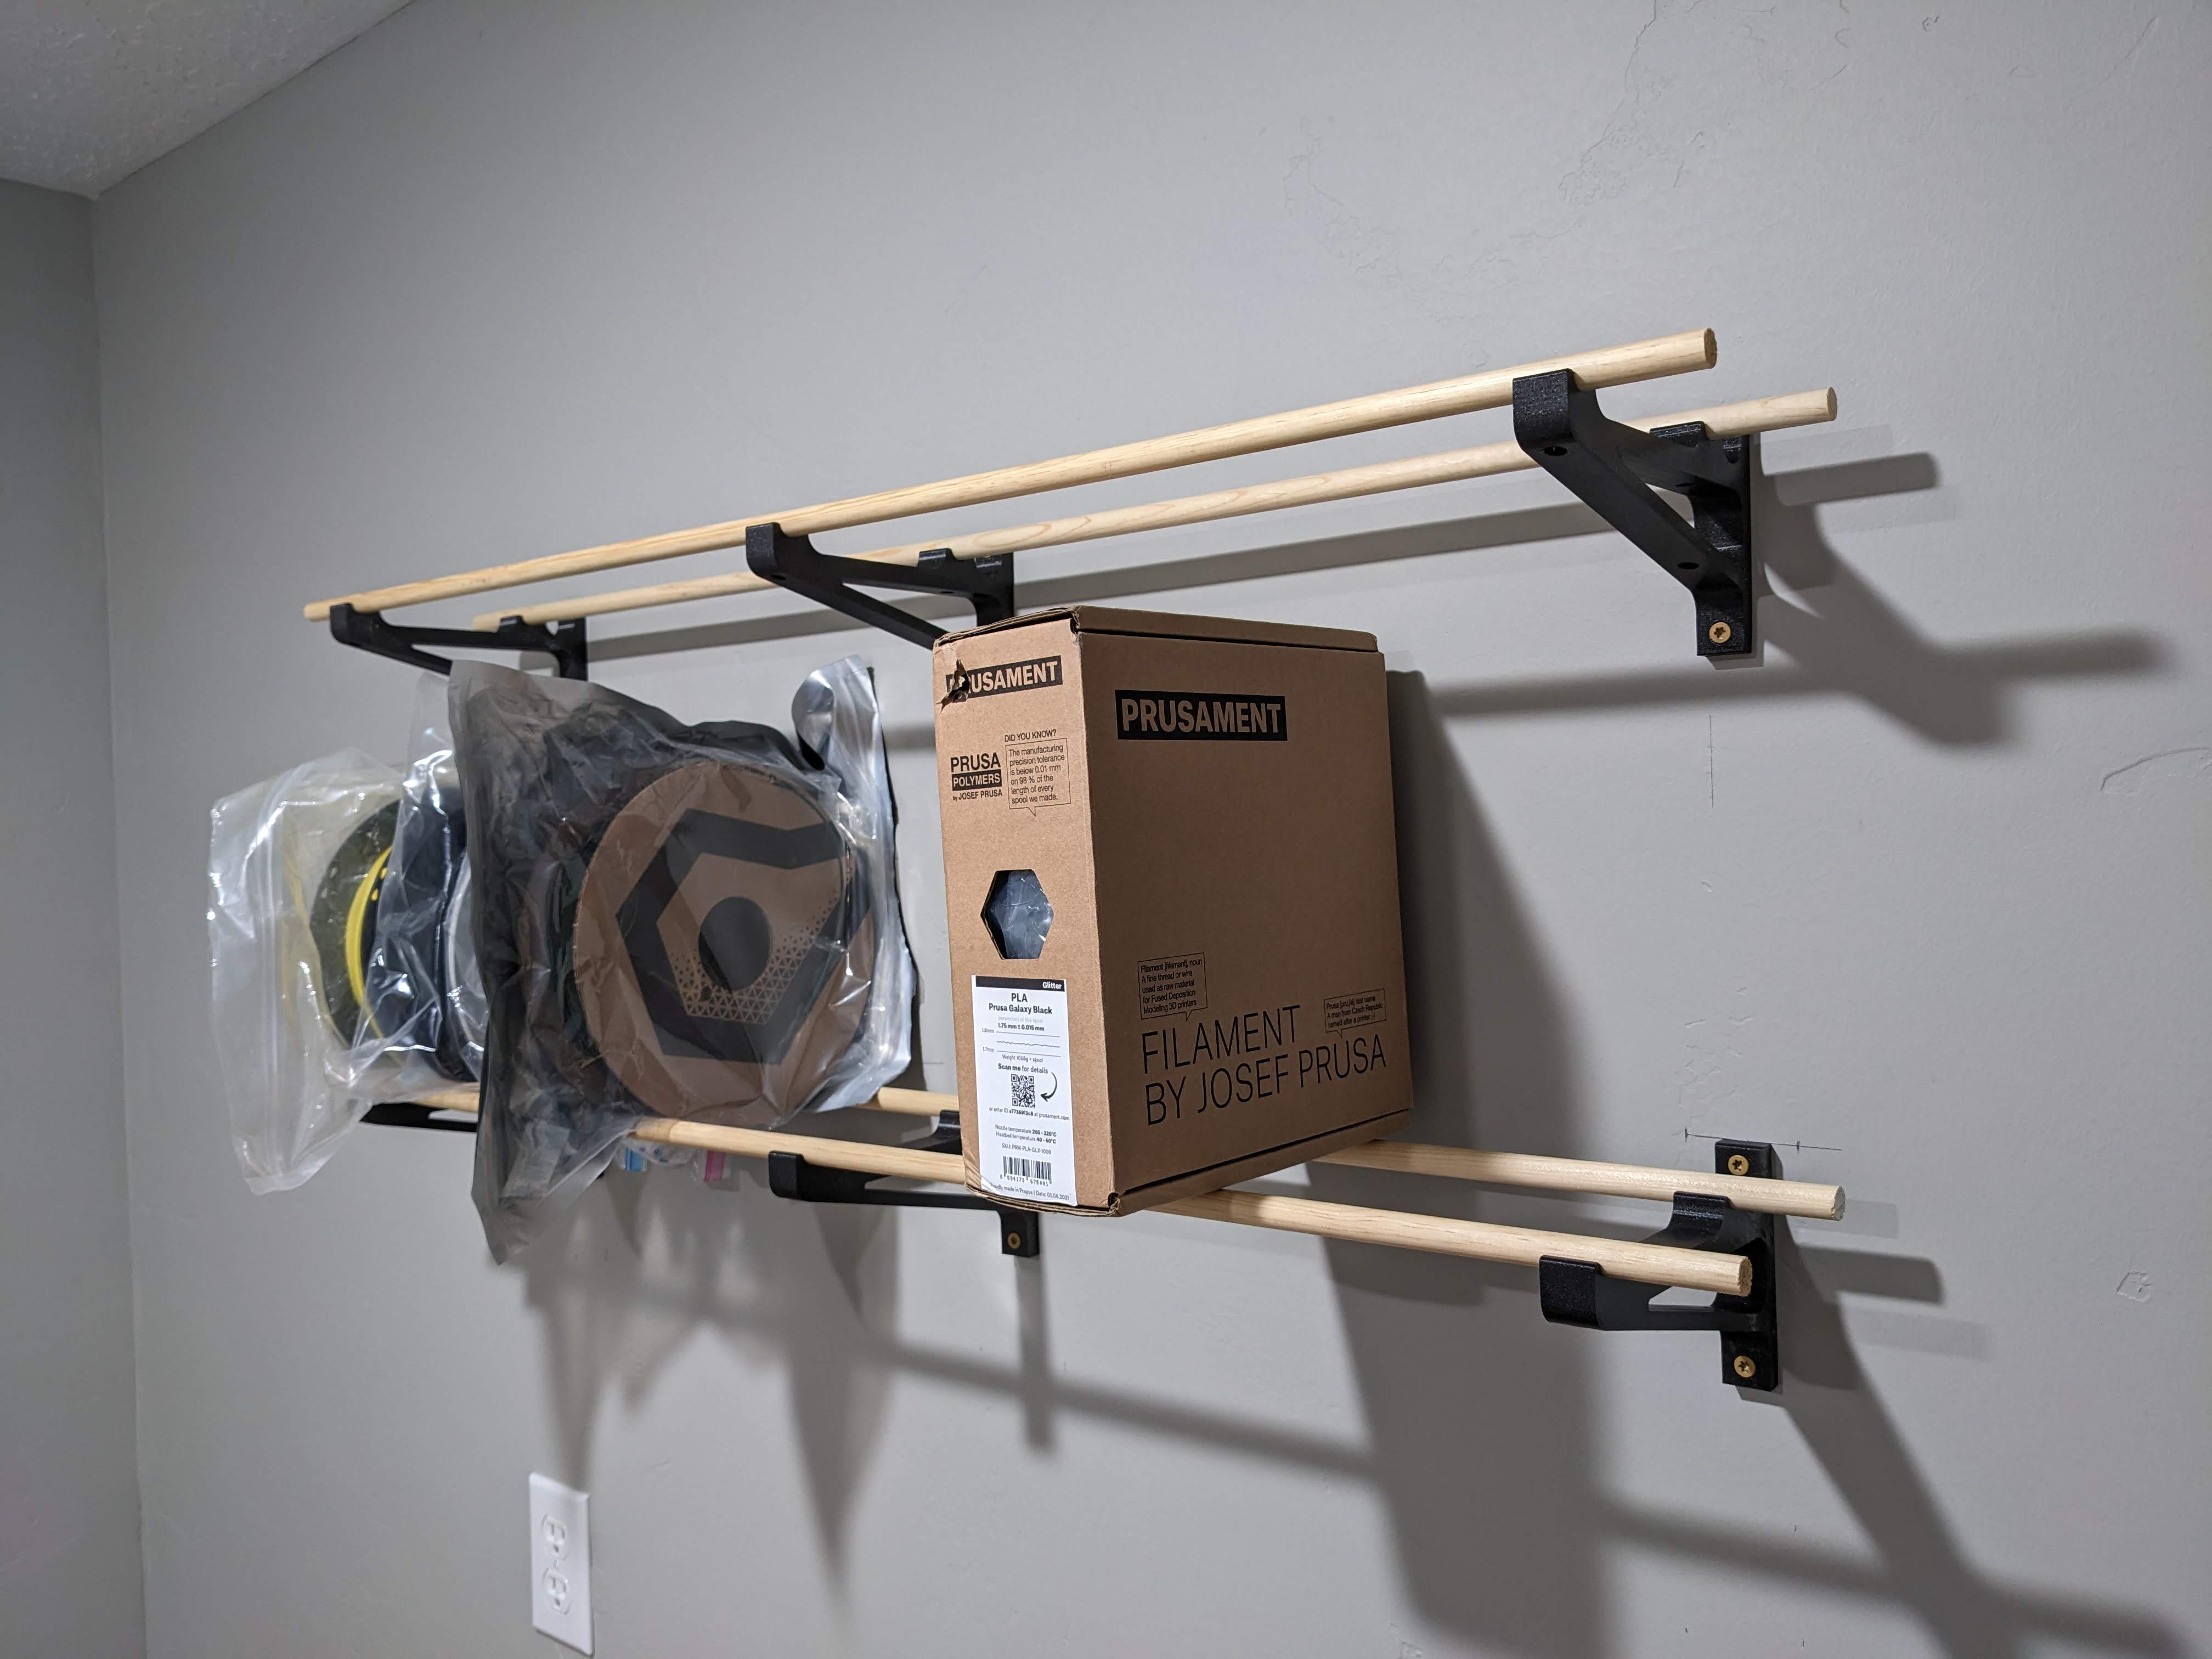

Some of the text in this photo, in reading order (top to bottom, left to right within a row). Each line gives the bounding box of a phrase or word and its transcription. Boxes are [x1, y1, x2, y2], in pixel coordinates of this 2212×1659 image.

[950, 661, 1058, 695] USAMENT
[1121, 698, 1281, 733] PRUSAMENT
[1017, 732, 1031, 741] YOU
[1032, 729, 1057, 739] KNOW?
[1022, 744, 1063, 755] manufacturing
[951, 752, 1001, 772] PRUSA
[1009, 755, 1064, 767] precision tolerance
[1017, 767, 1034, 775] below
[1035, 765, 1047, 774] 0.01
[953, 773, 1000, 787] POLYMERS
[1036, 775, 1042, 783] of
[958, 791, 979, 800] JOSEF
[980, 789, 1002, 798] PRUSA
[1011, 787, 1029, 795] length
[1037, 785, 1054, 793] every
[1012, 795, 1028, 805] spool
[1039, 793, 1058, 802] made.
[1141, 963, 1164, 973] Filament
[1147, 974, 1157, 983] fine
[1158, 972, 1174, 981] thread
[1181, 969, 1193, 977] wire
[1042, 981, 1062, 989] Glitter
[1142, 985, 1155, 994] used
[1175, 979, 1194, 989] material
[1011, 992, 1028, 1002] PLA
[1152, 993, 1167, 1002] Fused
[1169, 989, 1196, 999] Deposition
[989, 1003, 1052, 1014] Prusa Galaxy Black
[1143, 999, 1197, 1014] Modeling 3D printers
[1142, 1005, 1300, 1074] FILAMENT
[1030, 1065, 1048, 1074] details
[1146, 1034, 1386, 1126] BY JOSEF PRUSA
[1008, 1126, 1031, 1135] temperature
[1012, 1132, 1036, 1142] temperature
[1012, 1144, 1052, 1155] PRM-PLA-GLX-1000
